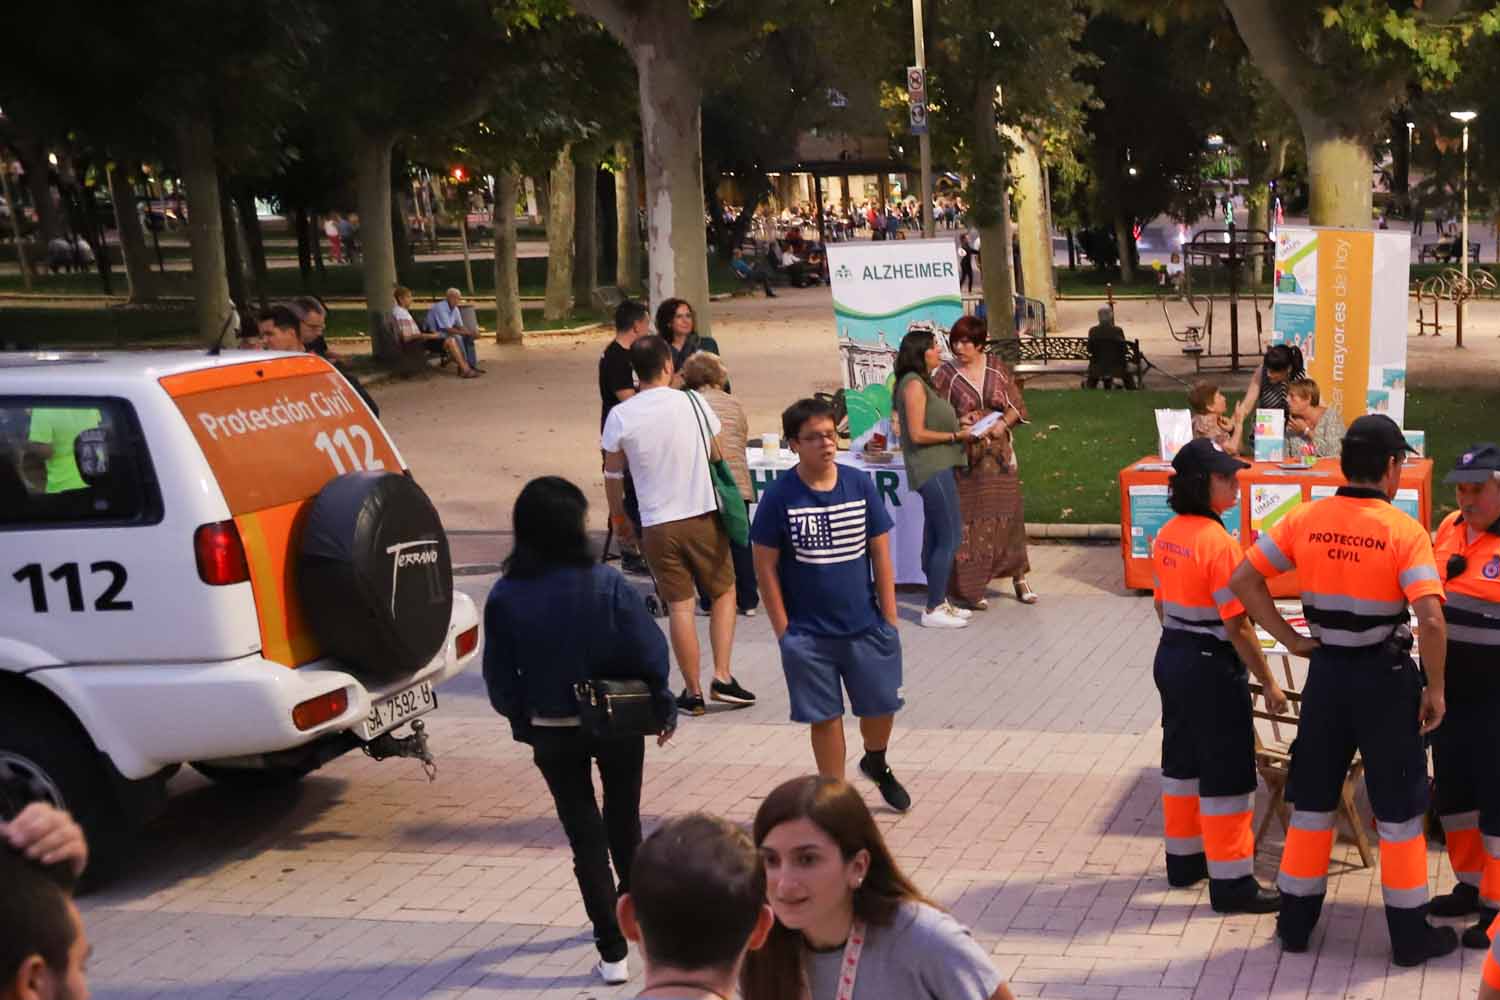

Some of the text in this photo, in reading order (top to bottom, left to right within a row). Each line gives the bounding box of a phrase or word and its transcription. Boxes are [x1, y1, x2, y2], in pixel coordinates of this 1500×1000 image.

[862, 262, 955, 281] ALZHEIMER
[198, 390, 356, 441] Protección Civil
[314, 424, 385, 476] 112
[797, 515, 818, 536] 76
[1327, 549, 1361, 563] CIVIL
[12, 560, 134, 613] 112
